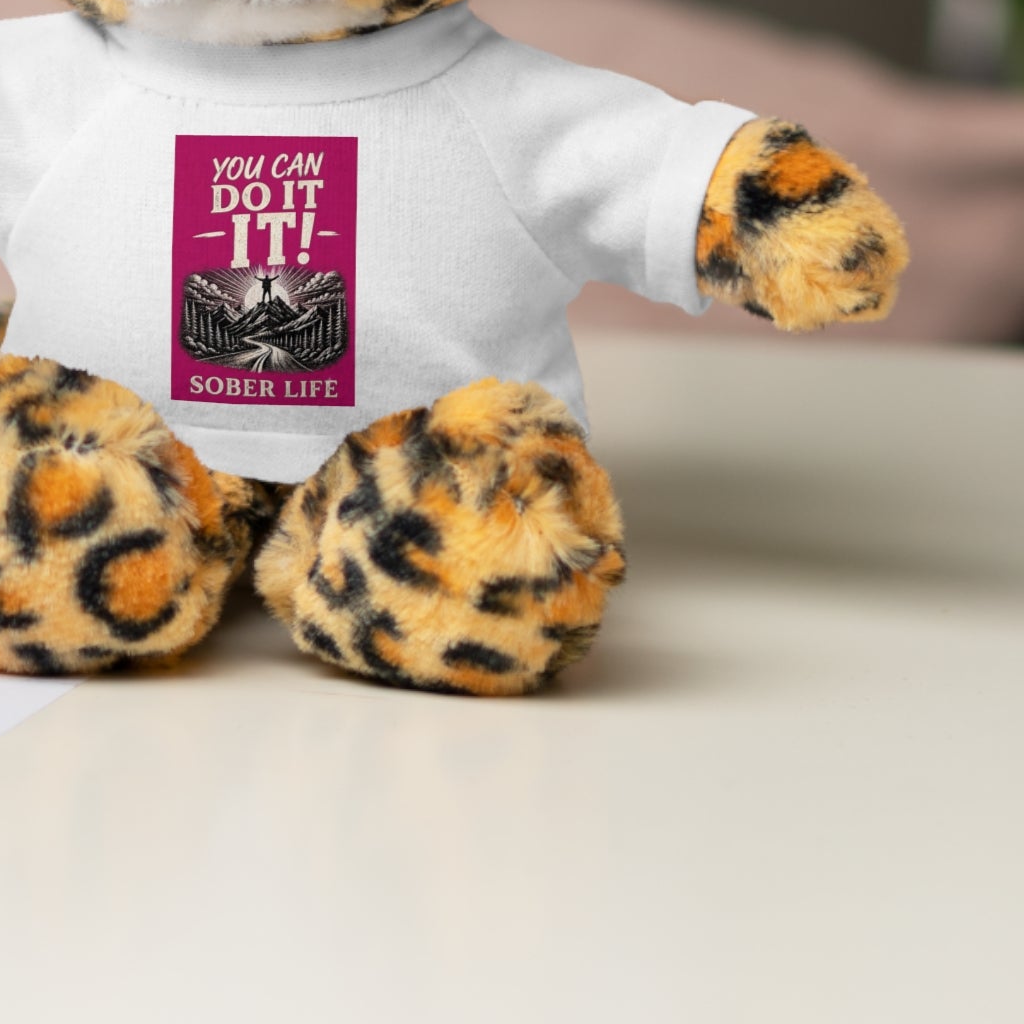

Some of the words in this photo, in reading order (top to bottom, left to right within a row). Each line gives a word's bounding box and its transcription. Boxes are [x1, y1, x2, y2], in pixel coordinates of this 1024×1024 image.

[212, 154, 266, 184] YOU
[270, 151, 325, 179] CAN
[210, 181, 272, 214] DO
[282, 179, 324, 210] IT
[230, 211, 316, 269] IT!
[189, 375, 276, 398] SOBER
[284, 379, 339, 399] LIFE
